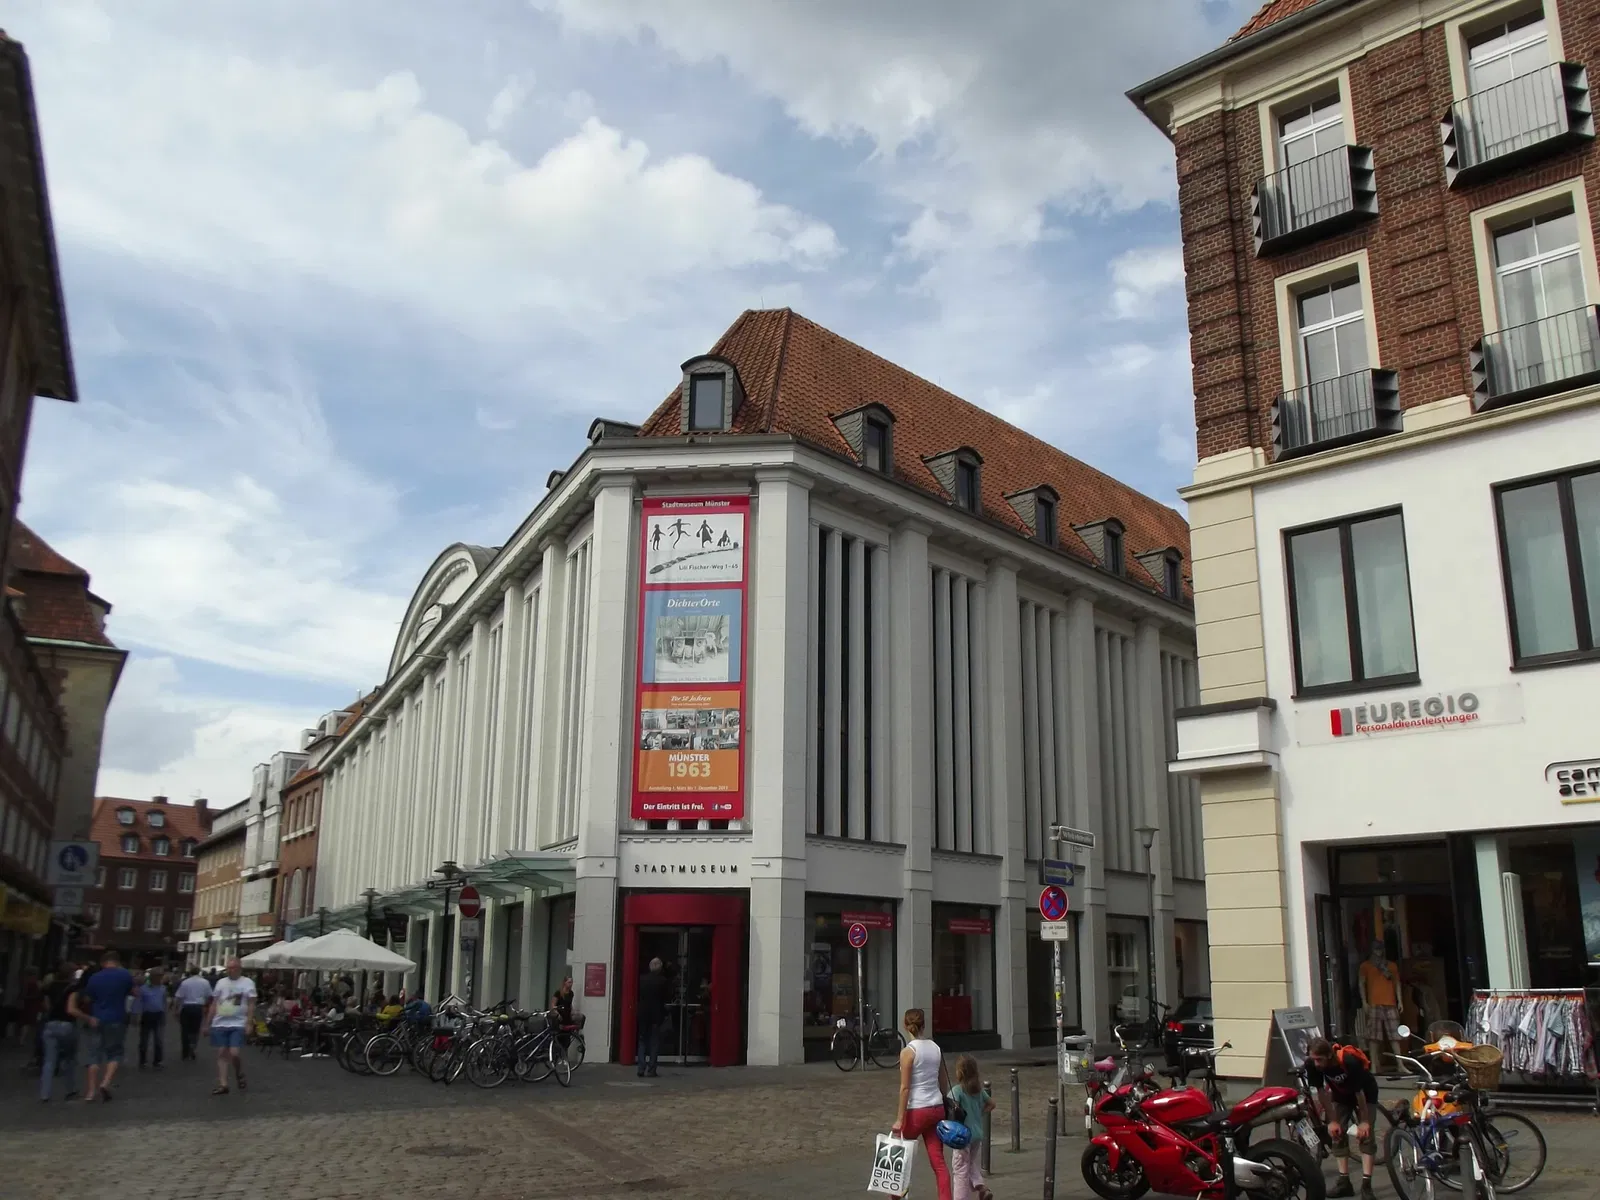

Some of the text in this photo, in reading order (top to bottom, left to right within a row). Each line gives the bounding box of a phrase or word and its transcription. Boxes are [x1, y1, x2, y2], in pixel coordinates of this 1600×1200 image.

[689, 564, 724, 572] Fischer-Weg
[667, 597, 720, 608] DichterOrte
[1355, 692, 1480, 724] EUREGIO
[1355, 711, 1479, 733] Personaldienstleistungen
[669, 751, 710, 762] MÜNSTER
[668, 762, 711, 777] 1963
[634, 864, 738, 873] STADTMUSEUM
[873, 1169, 901, 1182] BIKE
[872, 1179, 900, 1191] & CO
